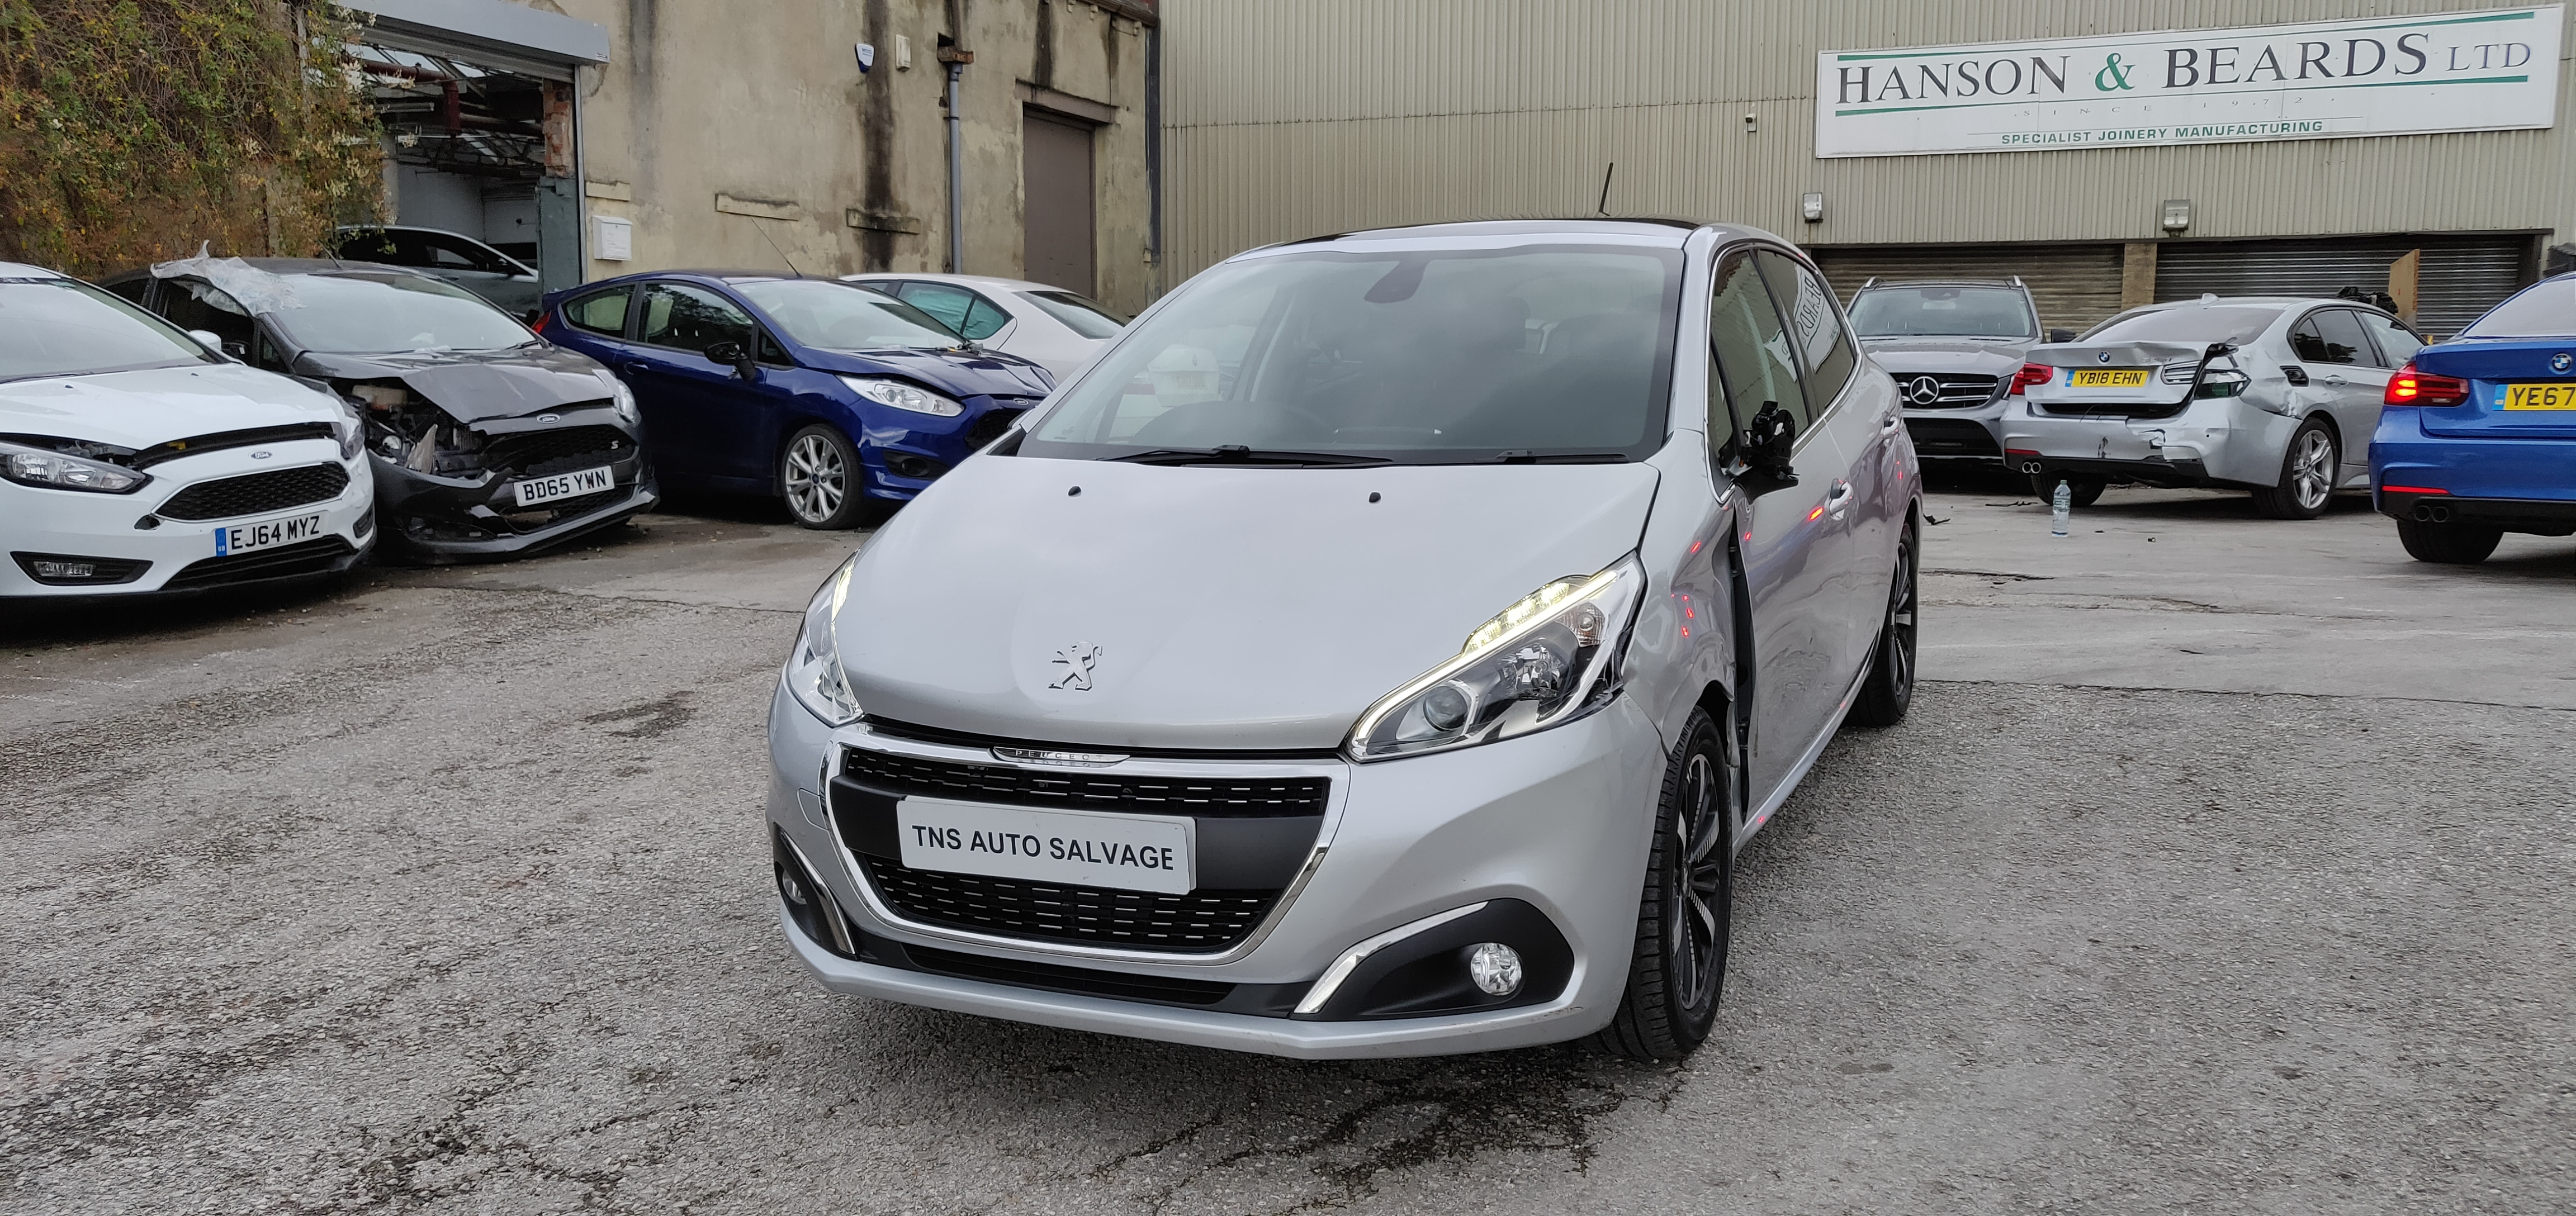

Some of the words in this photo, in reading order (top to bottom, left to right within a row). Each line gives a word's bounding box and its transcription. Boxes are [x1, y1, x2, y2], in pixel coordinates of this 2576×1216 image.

[1836, 55, 2071, 104] HANSON
[2095, 53, 2136, 92] &
[2162, 33, 2429, 89] BEARDS
[2446, 42, 2531, 72] LTD
[2002, 131, 2091, 145] SPECIALIST
[2098, 129, 2167, 141] JOINERY
[2175, 121, 2323, 138] MANUFACTURING
[2080, 372, 2110, 384] YB18
[2112, 372, 2143, 384] EHN
[2512, 387, 2576, 406] YE67
[523, 477, 570, 501] BD65
[574, 470, 607, 491] YWN
[231, 522, 281, 550] EJ64
[287, 515, 320, 540] MYZ
[1015, 749, 1104, 761] PEUGEOT
[912, 825, 962, 850] TNS
[970, 830, 1041, 857] AUTO
[1049, 837, 1173, 871] SALVAGE
